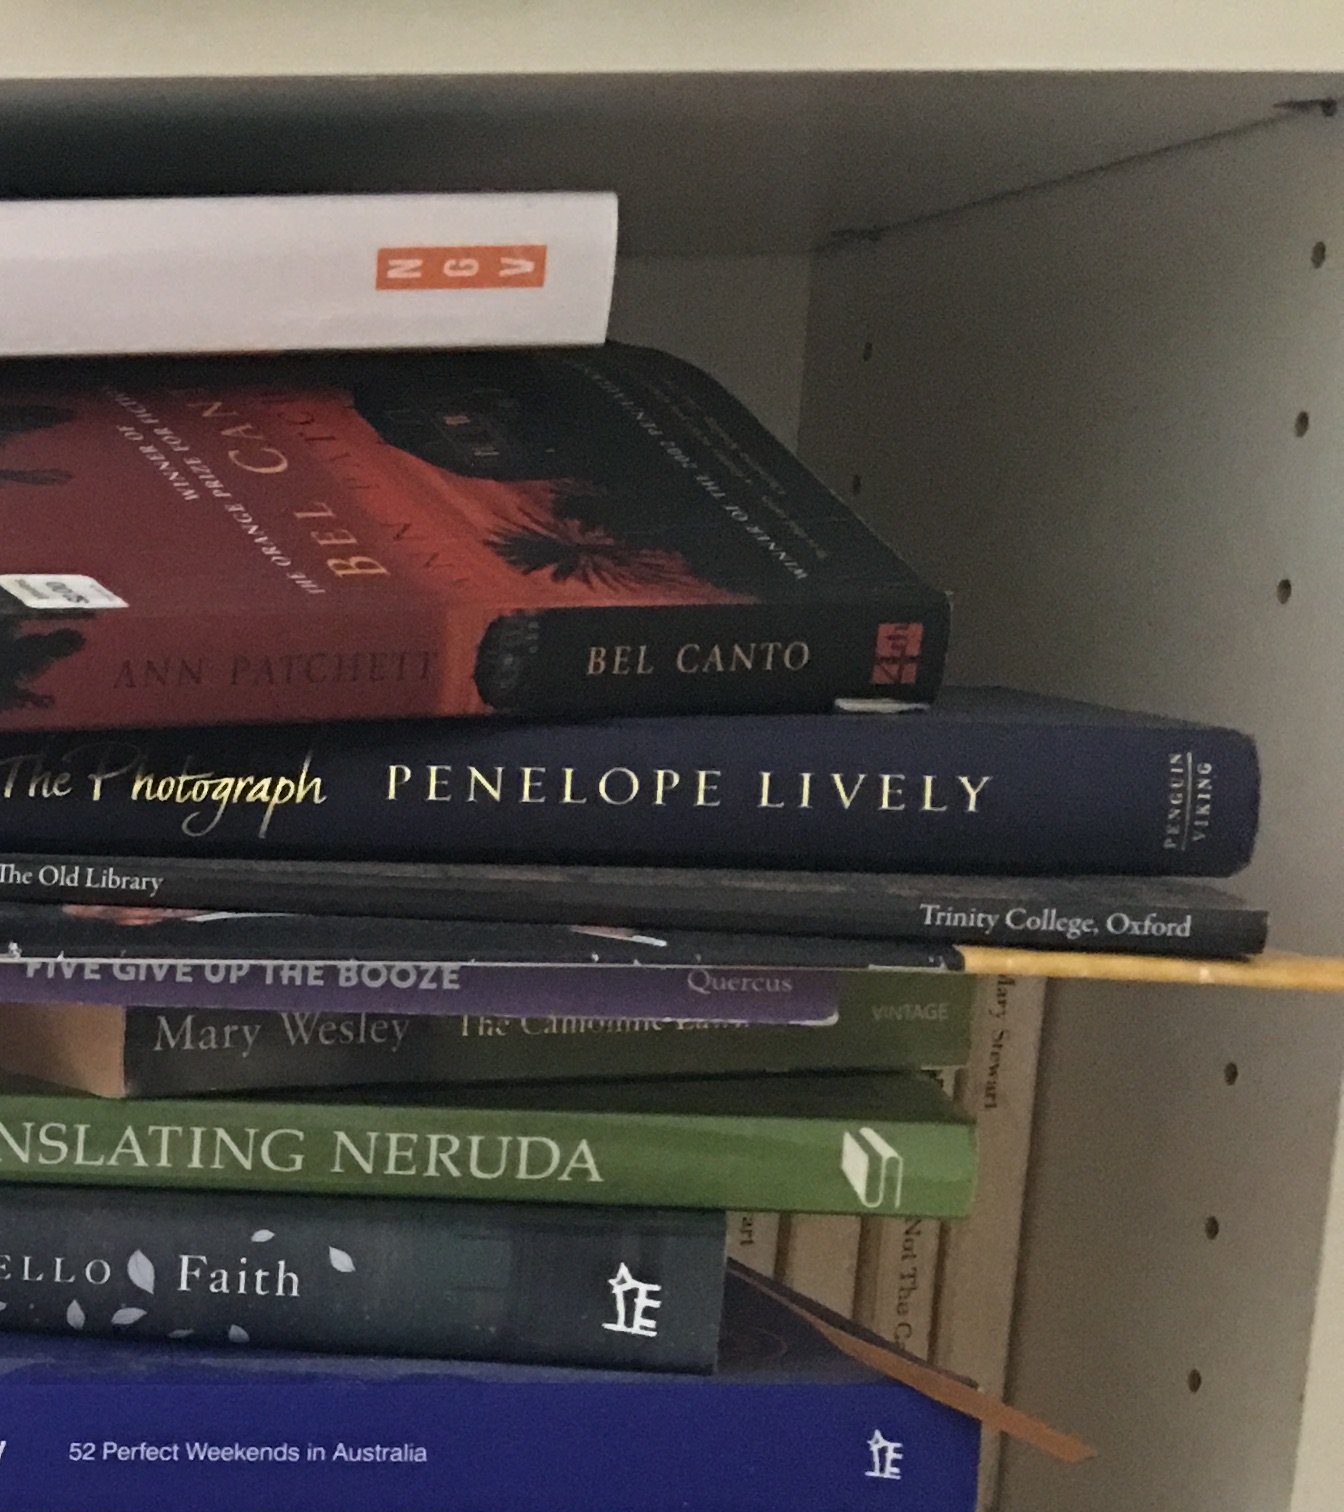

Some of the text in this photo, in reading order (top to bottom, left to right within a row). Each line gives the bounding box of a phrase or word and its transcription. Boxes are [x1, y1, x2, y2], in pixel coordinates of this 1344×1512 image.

[585, 641, 811, 676] BEL CANTO
[386, 764, 994, 814] PENELOPE LIVELY
[1164, 751, 1184, 851] PENGUIN
[1191, 761, 1213, 842] VIKING
[39, 862, 80, 889] Old
[86, 866, 165, 897] Library
[920, 903, 1192, 939] Trinity College, Oxford
[687, 969, 793, 995] Quercus
[872, 1003, 949, 1024] VINTAGE
[329, 1130, 604, 1184] NERUDA
[177, 1253, 302, 1298] Faith
[68, 1441, 429, 1464] 52 Perfect Weekends in Australia
